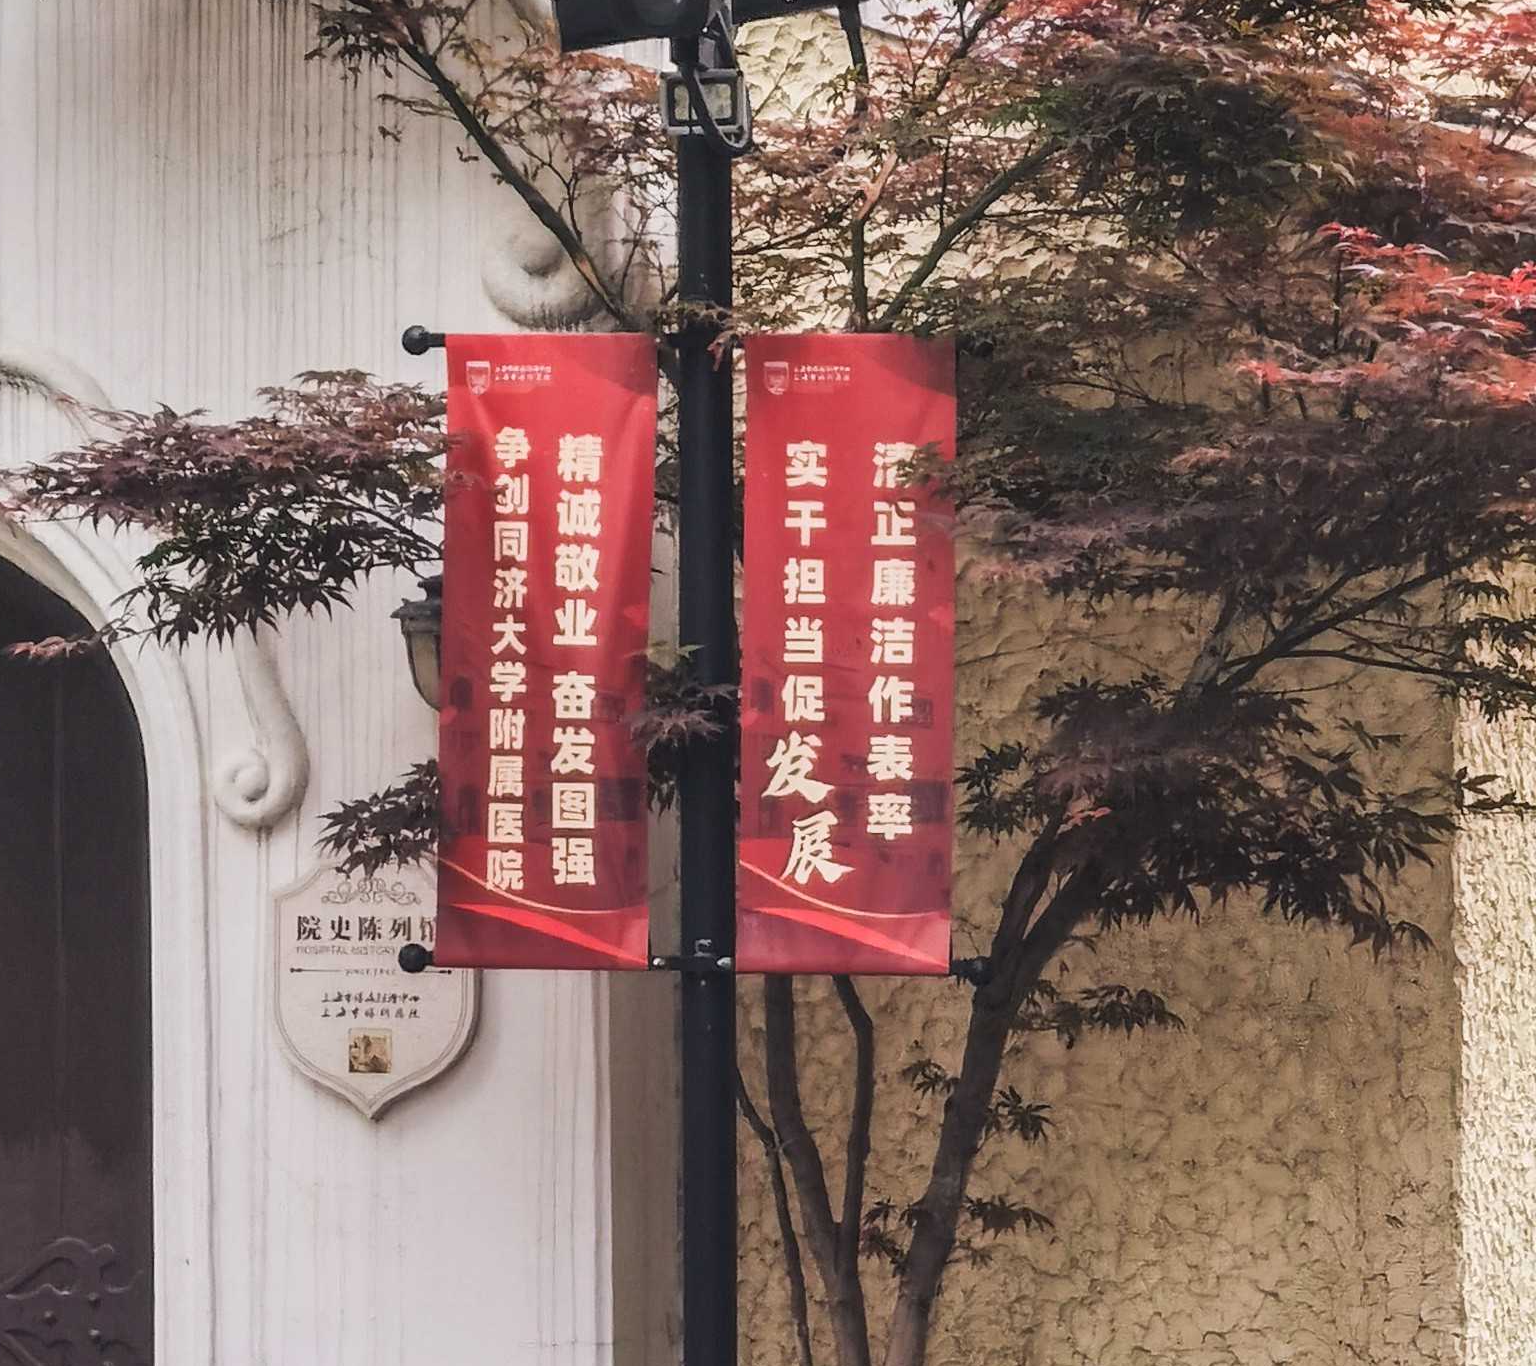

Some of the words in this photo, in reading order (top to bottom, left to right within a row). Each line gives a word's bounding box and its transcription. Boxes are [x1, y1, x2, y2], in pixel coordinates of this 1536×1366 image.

[486, 427, 532, 891] 争创同济大学附属医院
[760, 441, 855, 886] 实干担当促发展
